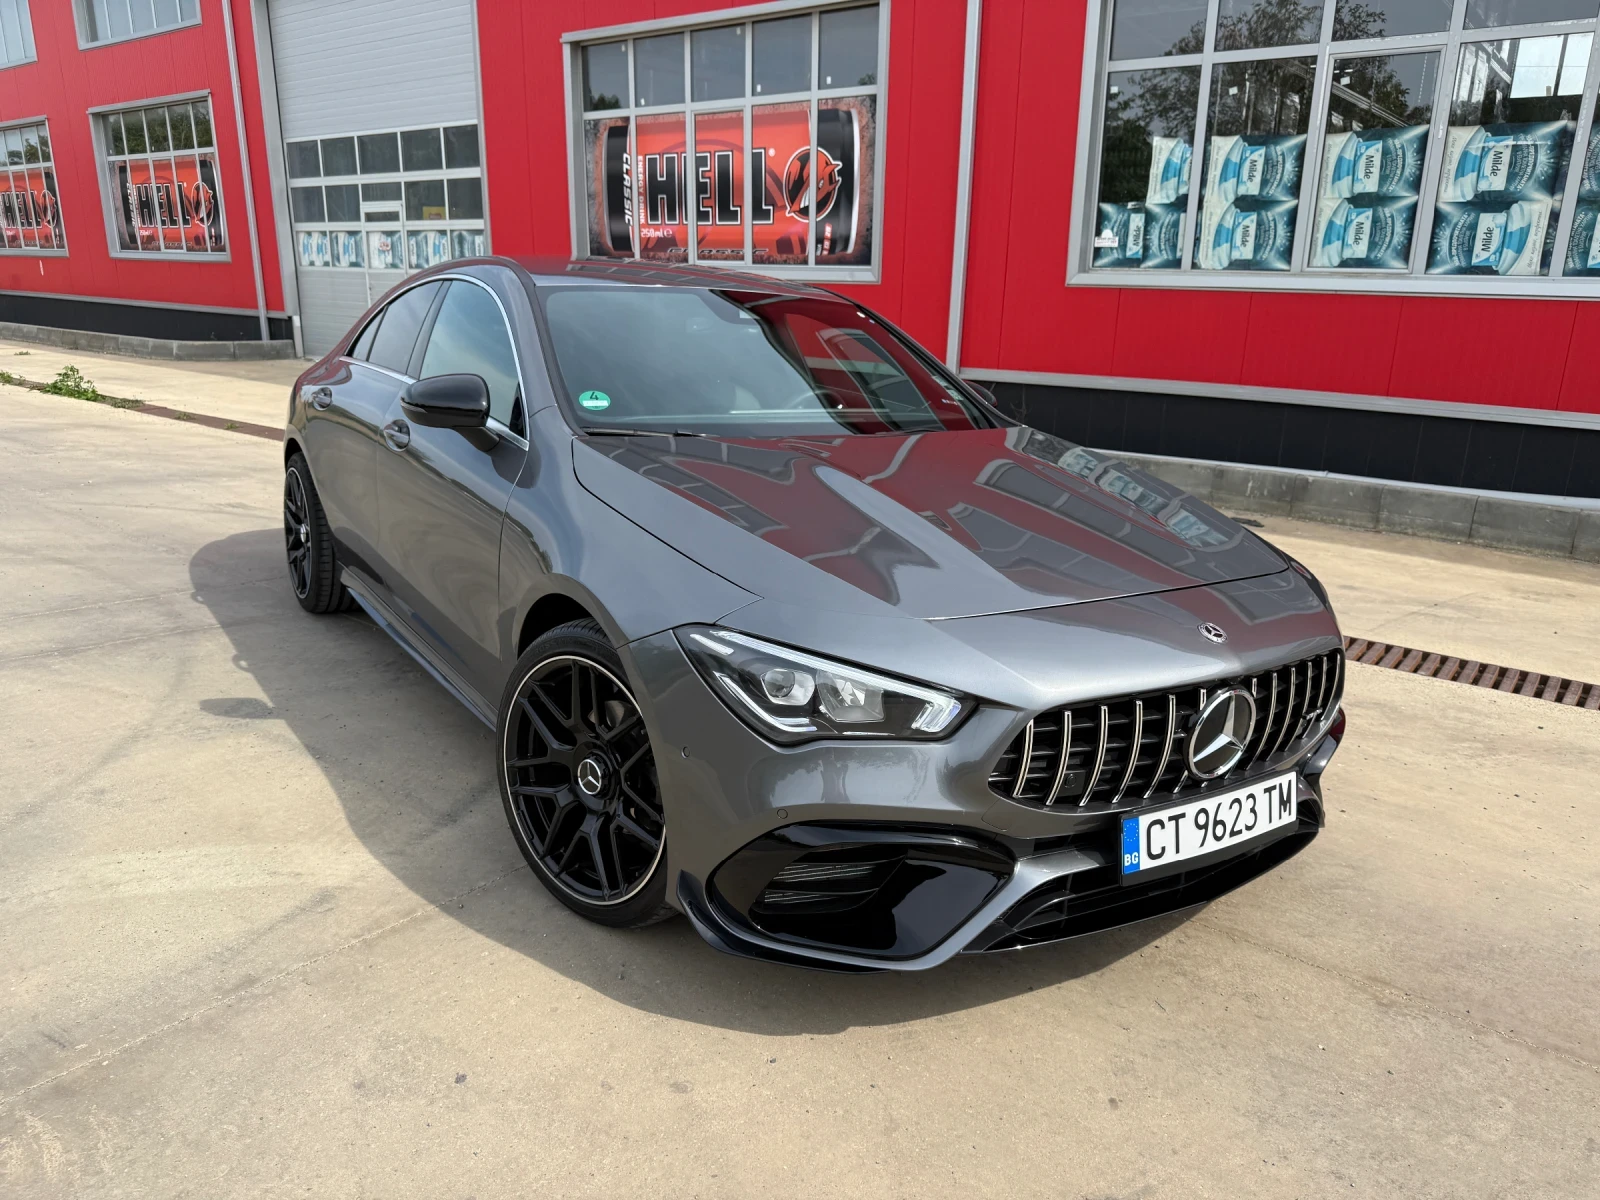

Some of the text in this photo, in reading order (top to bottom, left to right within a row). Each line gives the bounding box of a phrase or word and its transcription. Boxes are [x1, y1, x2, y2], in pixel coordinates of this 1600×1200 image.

[1246, 158, 1258, 183] Milde
[1364, 154, 1375, 180] Milde
[1489, 150, 1504, 177] Milde
[623, 152, 633, 226] CLASSIC
[645, 148, 773, 224] HELL
[1, 191, 42, 229] HELL
[136, 183, 191, 227] HELL
[638, 196, 646, 224] DRINK
[1132, 225, 1142, 247] Milde
[1240, 224, 1251, 248] Milde
[1352, 221, 1365, 246] Milde
[1481, 226, 1495, 252] Milde
[590, 391, 599, 400] 4
[1146, 779, 1292, 860] CT 9623 TM
[1124, 852, 1139, 867] BG
